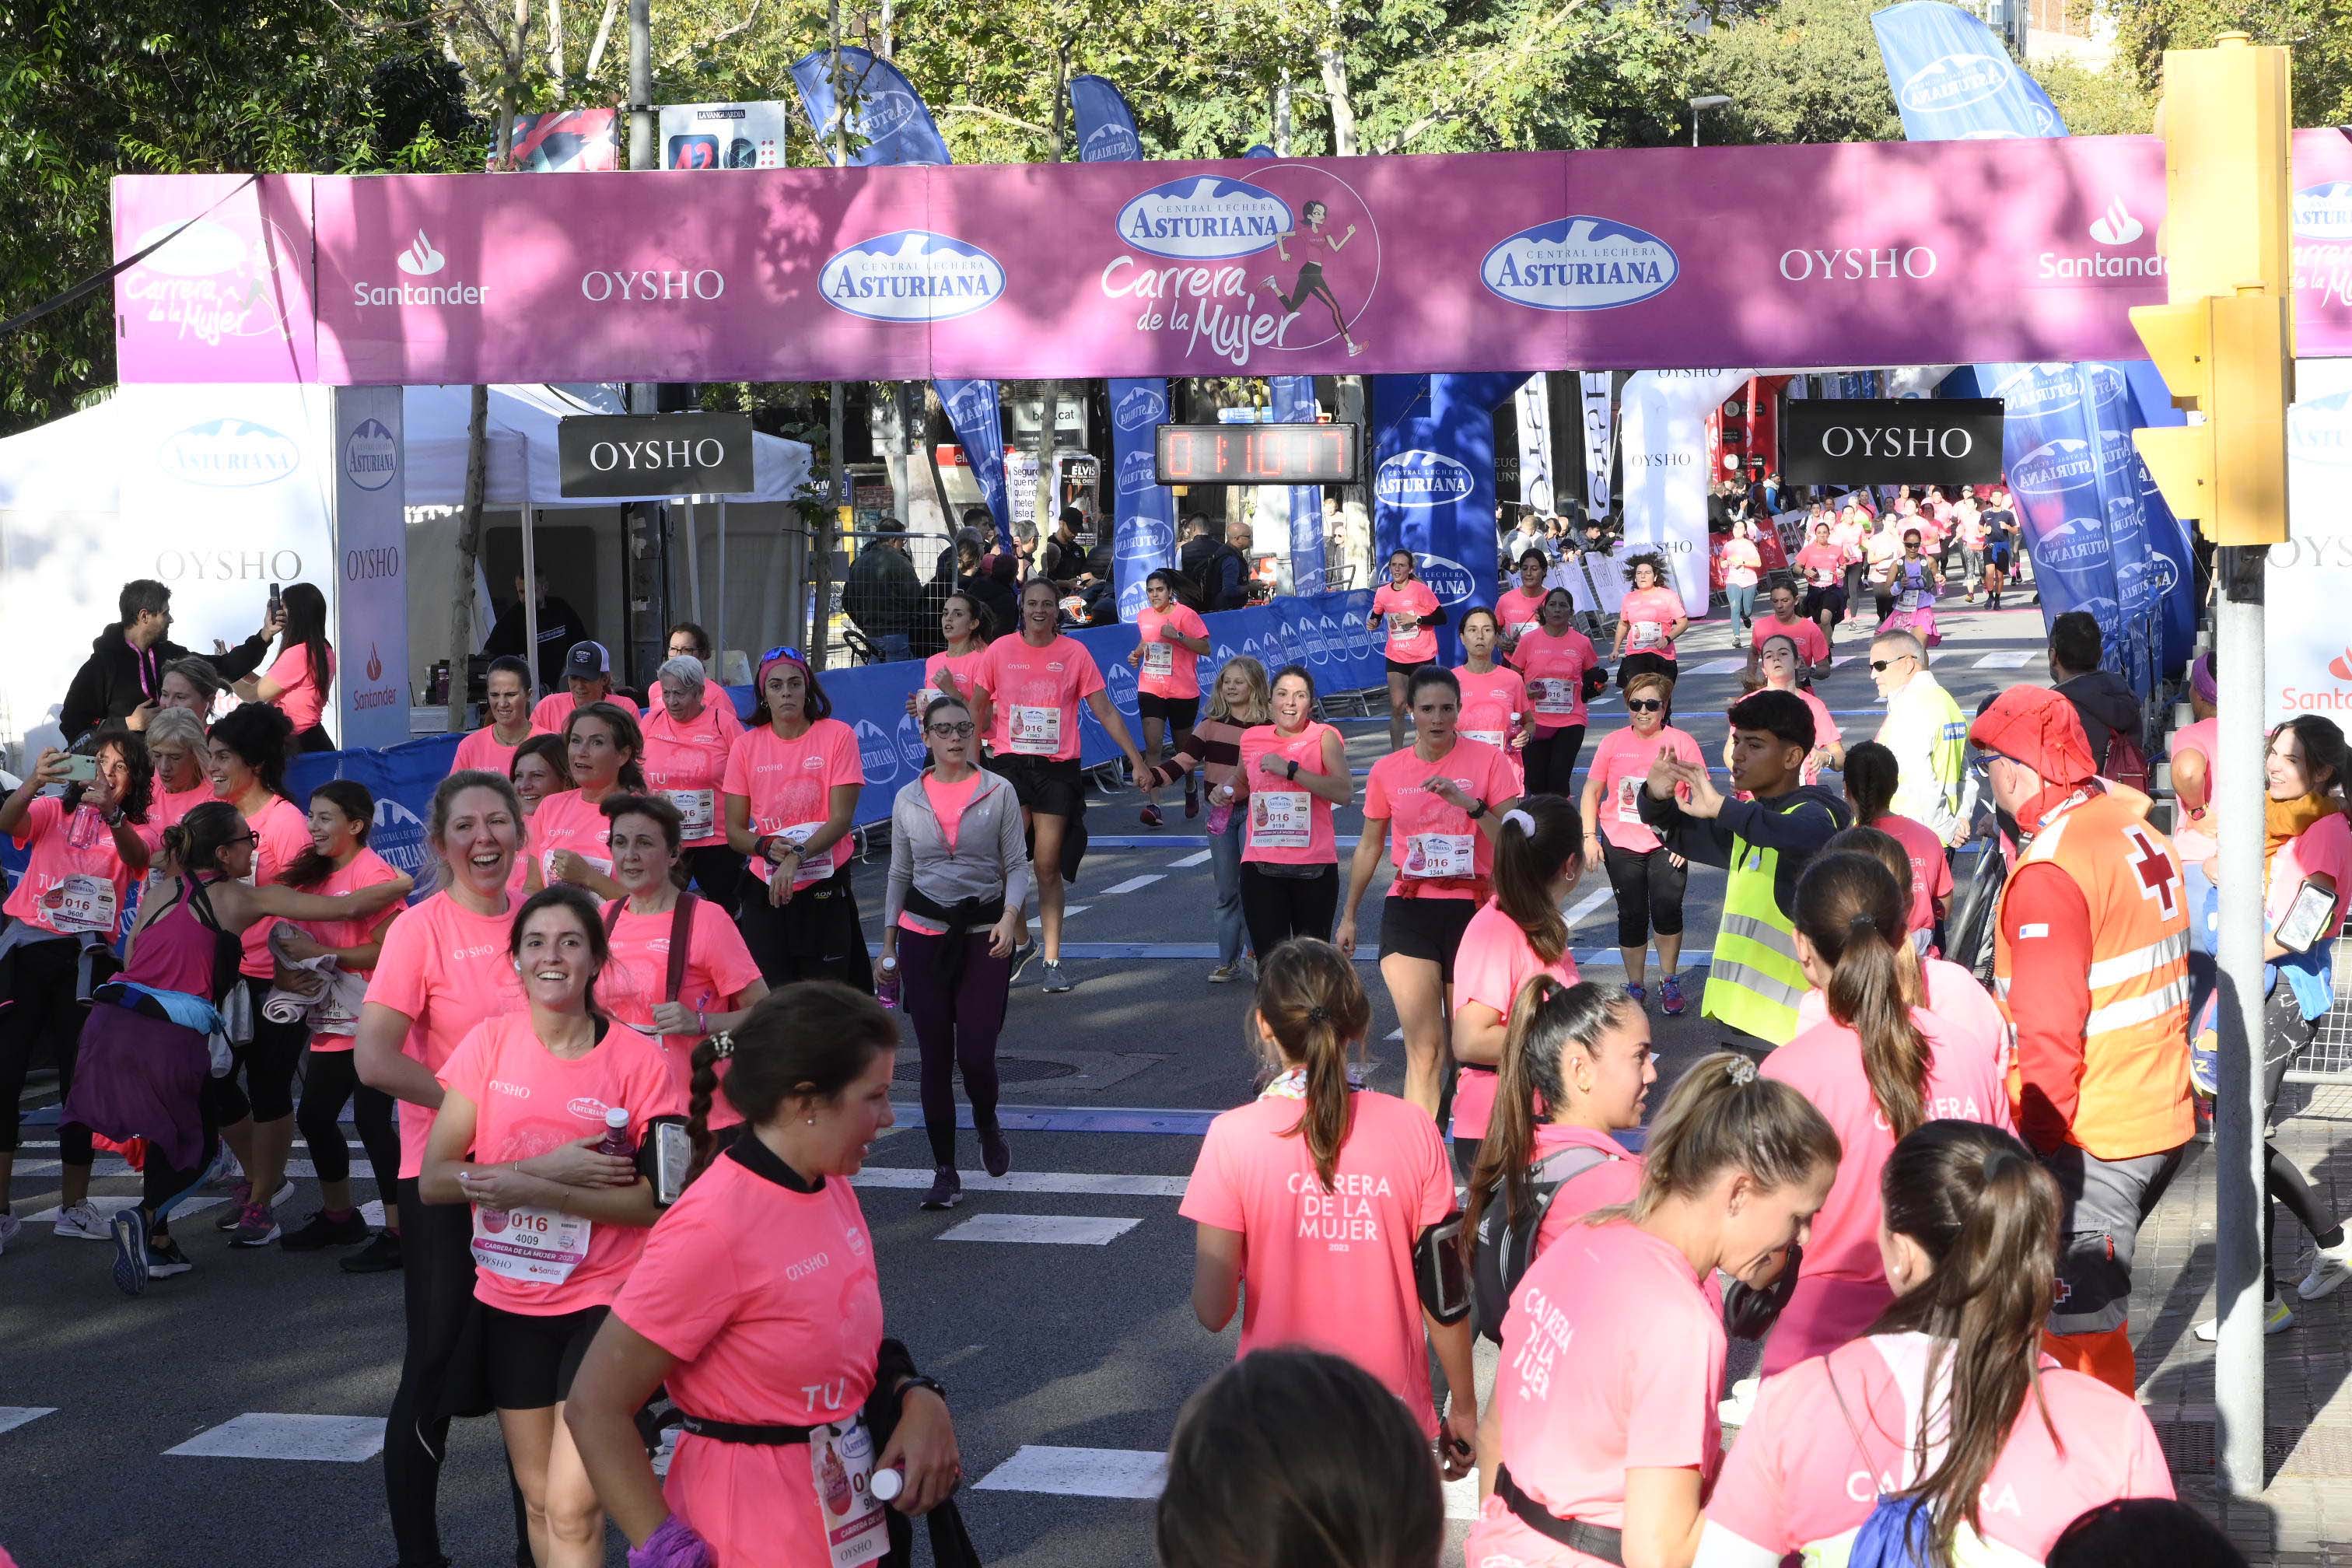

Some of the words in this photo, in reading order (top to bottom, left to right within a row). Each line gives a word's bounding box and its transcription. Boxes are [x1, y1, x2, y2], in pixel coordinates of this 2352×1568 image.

[1157, 205, 1213, 213] CENTRAL
[1218, 203, 1274, 212] LECHERA
[1129, 211, 1278, 238] ASTURIANA
[1526, 248, 1587, 258] CENTRAL
[1594, 247, 1657, 257] LECHERA
[1779, 247, 1937, 280] OYSHO
[862, 261, 919, 271] CENTRAL
[927, 261, 985, 271] LECHERA
[1101, 255, 1249, 299] Carrera
[1496, 251, 1664, 288] ASTURIANA
[2039, 252, 2170, 278] Santand
[354, 282, 490, 306] Santander
[582, 270, 725, 302] OYSHO
[833, 267, 992, 298] ASTURIANA
[1136, 299, 1166, 331] de
[1169, 300, 1189, 331] la
[1186, 294, 1301, 366] Mujer
[589, 438, 725, 471] OYSHO
[1822, 427, 1972, 459] OYSHO
[348, 445, 394, 473] ASTURIANA
[1071, 465, 1096, 476] ELVIS
[1632, 453, 1691, 467] OYSHO
[1377, 471, 1467, 495] ASTURIANA
[1015, 509, 1030, 518] este
[156, 548, 303, 581] OYSHO
[347, 546, 398, 581] OYSHO
[353, 685, 397, 711] Santander
[649, 772, 667, 785] TU
[757, 763, 783, 773] OYSHO
[761, 817, 782, 831] TU
[1269, 813, 1290, 821] 016
[1427, 858, 1448, 867] 016
[39, 873, 57, 891] TU
[65, 898, 91, 911] 016
[453, 943, 494, 961] OYSHO
[488, 1080, 530, 1099] OYSHO
[1304, 1195, 1337, 1217] DE
[1342, 1199, 1373, 1219] LA
[511, 1212, 548, 1233] 016
[1297, 1218, 1378, 1242] MUJER
[485, 1241, 513, 1254] CARRERA
[533, 1251, 556, 1260] MUJER
[558, 1254, 575, 1262] 2023
[514, 1233, 539, 1246] 4009
[1328, 1244, 1349, 1252] 2023
[478, 1253, 513, 1270] OYSHO
[785, 1251, 831, 1283] OYSHO
[800, 1377, 847, 1413] TU
[852, 1467, 872, 1493] 01
[839, 1520, 867, 1539] CARRERA
[839, 1538, 873, 1562] OYSHO
